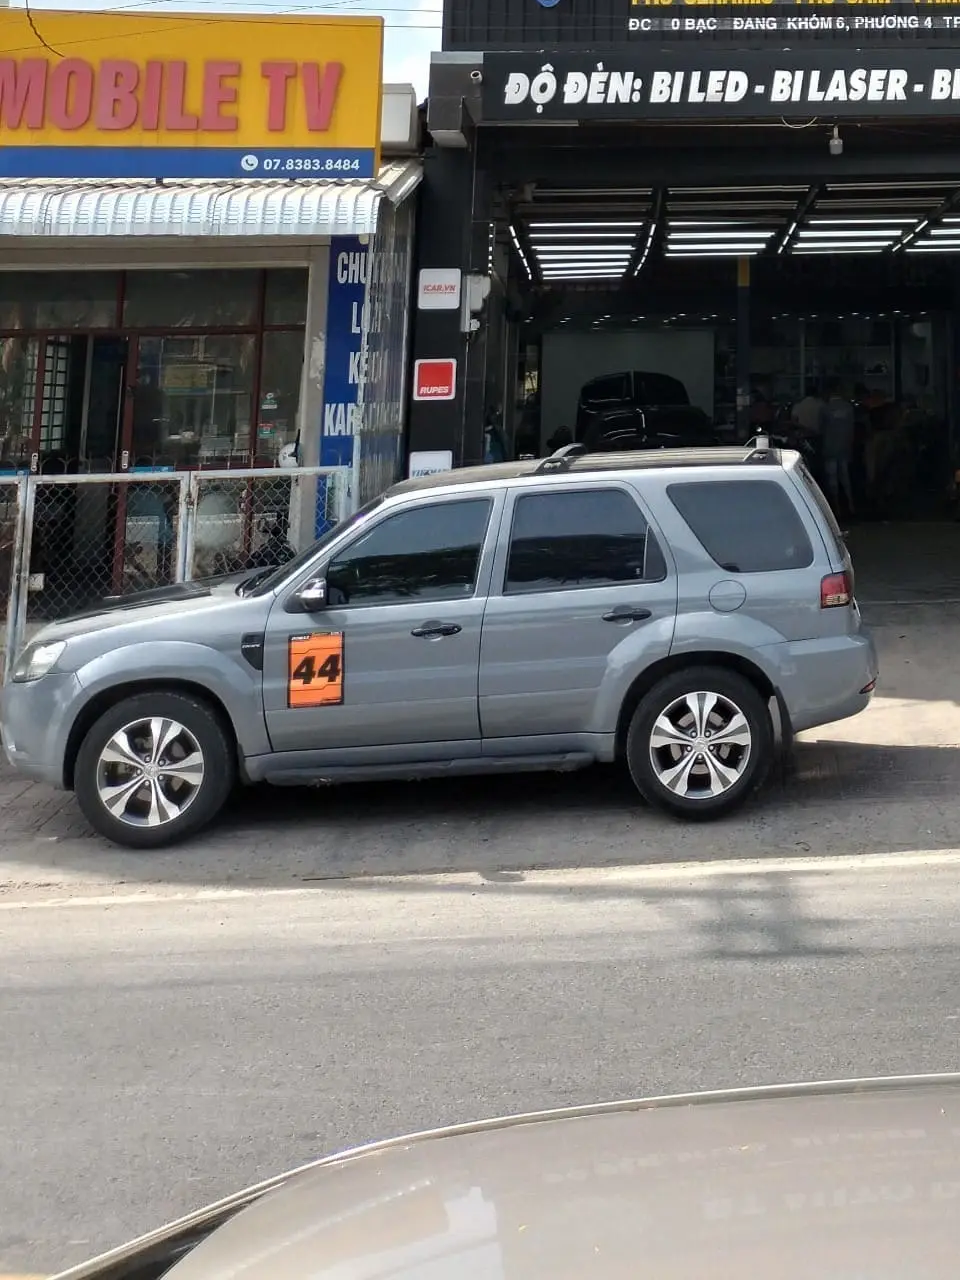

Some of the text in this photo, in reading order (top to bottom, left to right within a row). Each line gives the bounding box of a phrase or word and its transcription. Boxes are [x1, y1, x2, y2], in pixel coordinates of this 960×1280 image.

[787, 13, 832, 30] KHÓM
[0, 56, 344, 133] MOBILE TV
[504, 63, 558, 114] ĐỘ
[563, 62, 643, 105] ĐÈN:
[649, 70, 682, 104] BI
[688, 70, 749, 104] LED
[807, 68, 908, 102] LASER
[263, 157, 360, 172] 07.8383.8484
[419, 385, 450, 395] RUPES
[292, 653, 341, 686] 44
